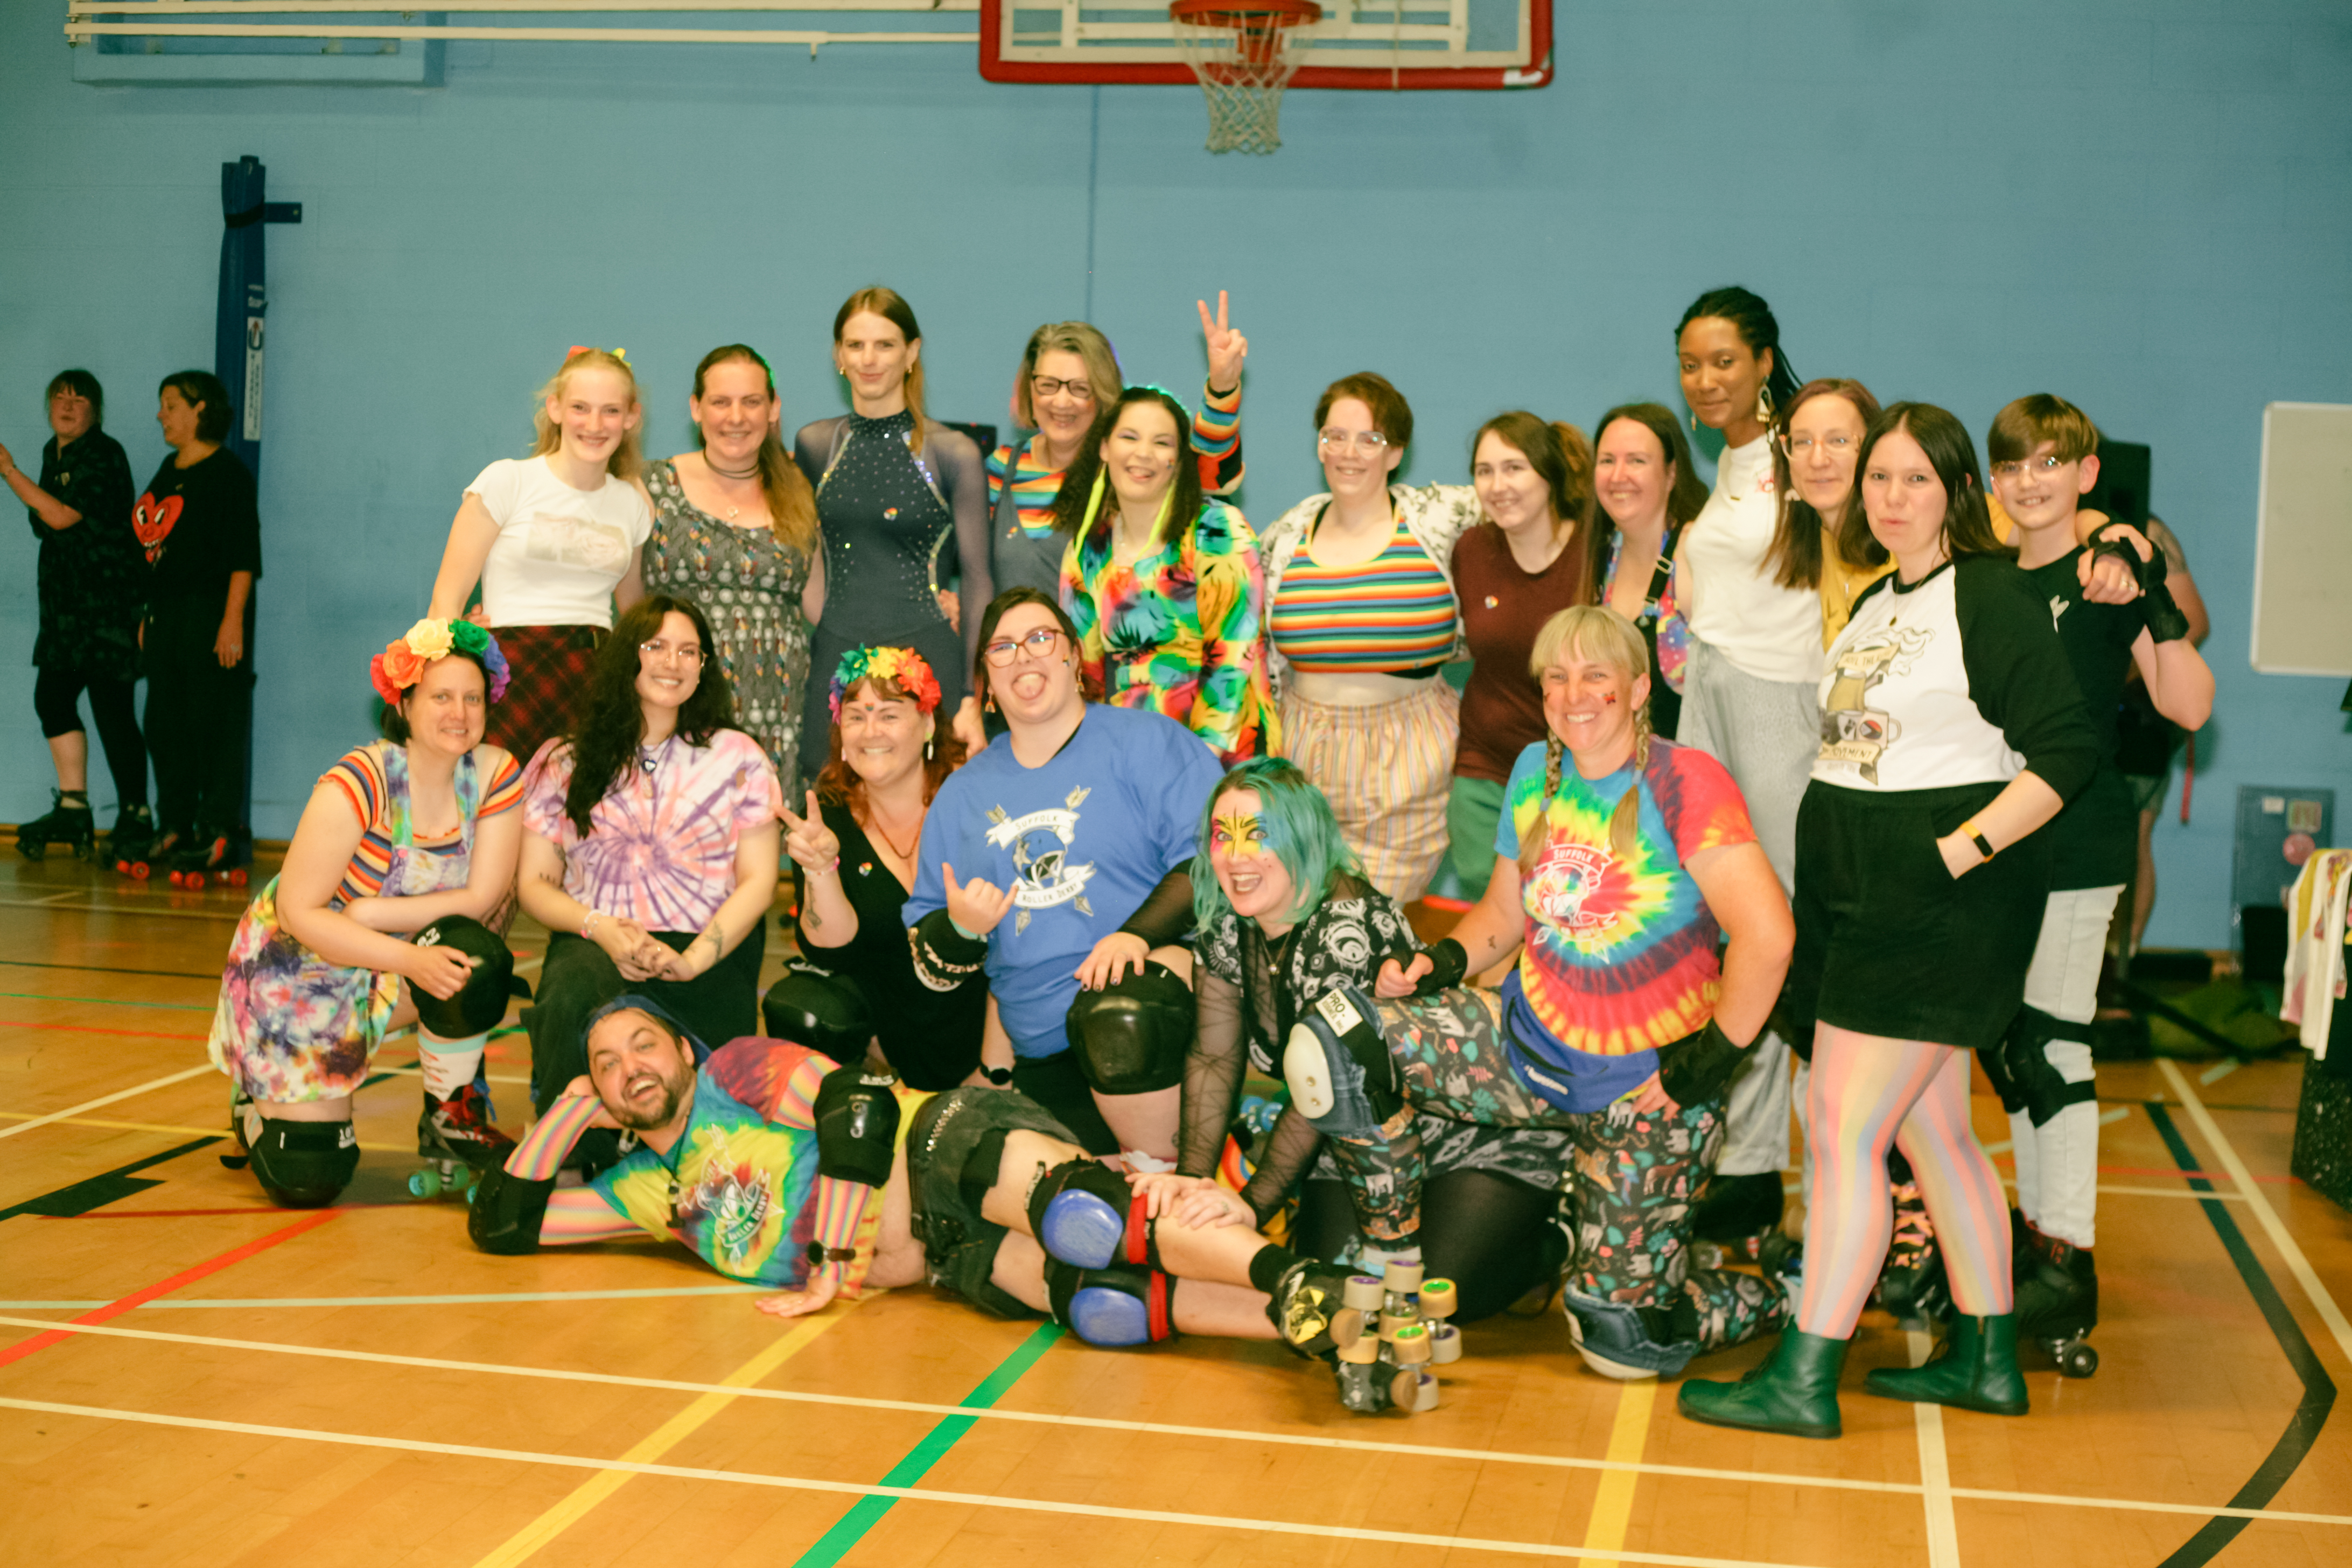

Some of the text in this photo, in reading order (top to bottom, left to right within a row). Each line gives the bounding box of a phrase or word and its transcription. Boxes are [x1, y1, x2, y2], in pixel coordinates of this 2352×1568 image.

[1015, 814, 1058, 831] SUFFOLK
[1553, 849, 1594, 864] SUFFOLK
[1022, 883, 1077, 904] ROLLER DERBY
